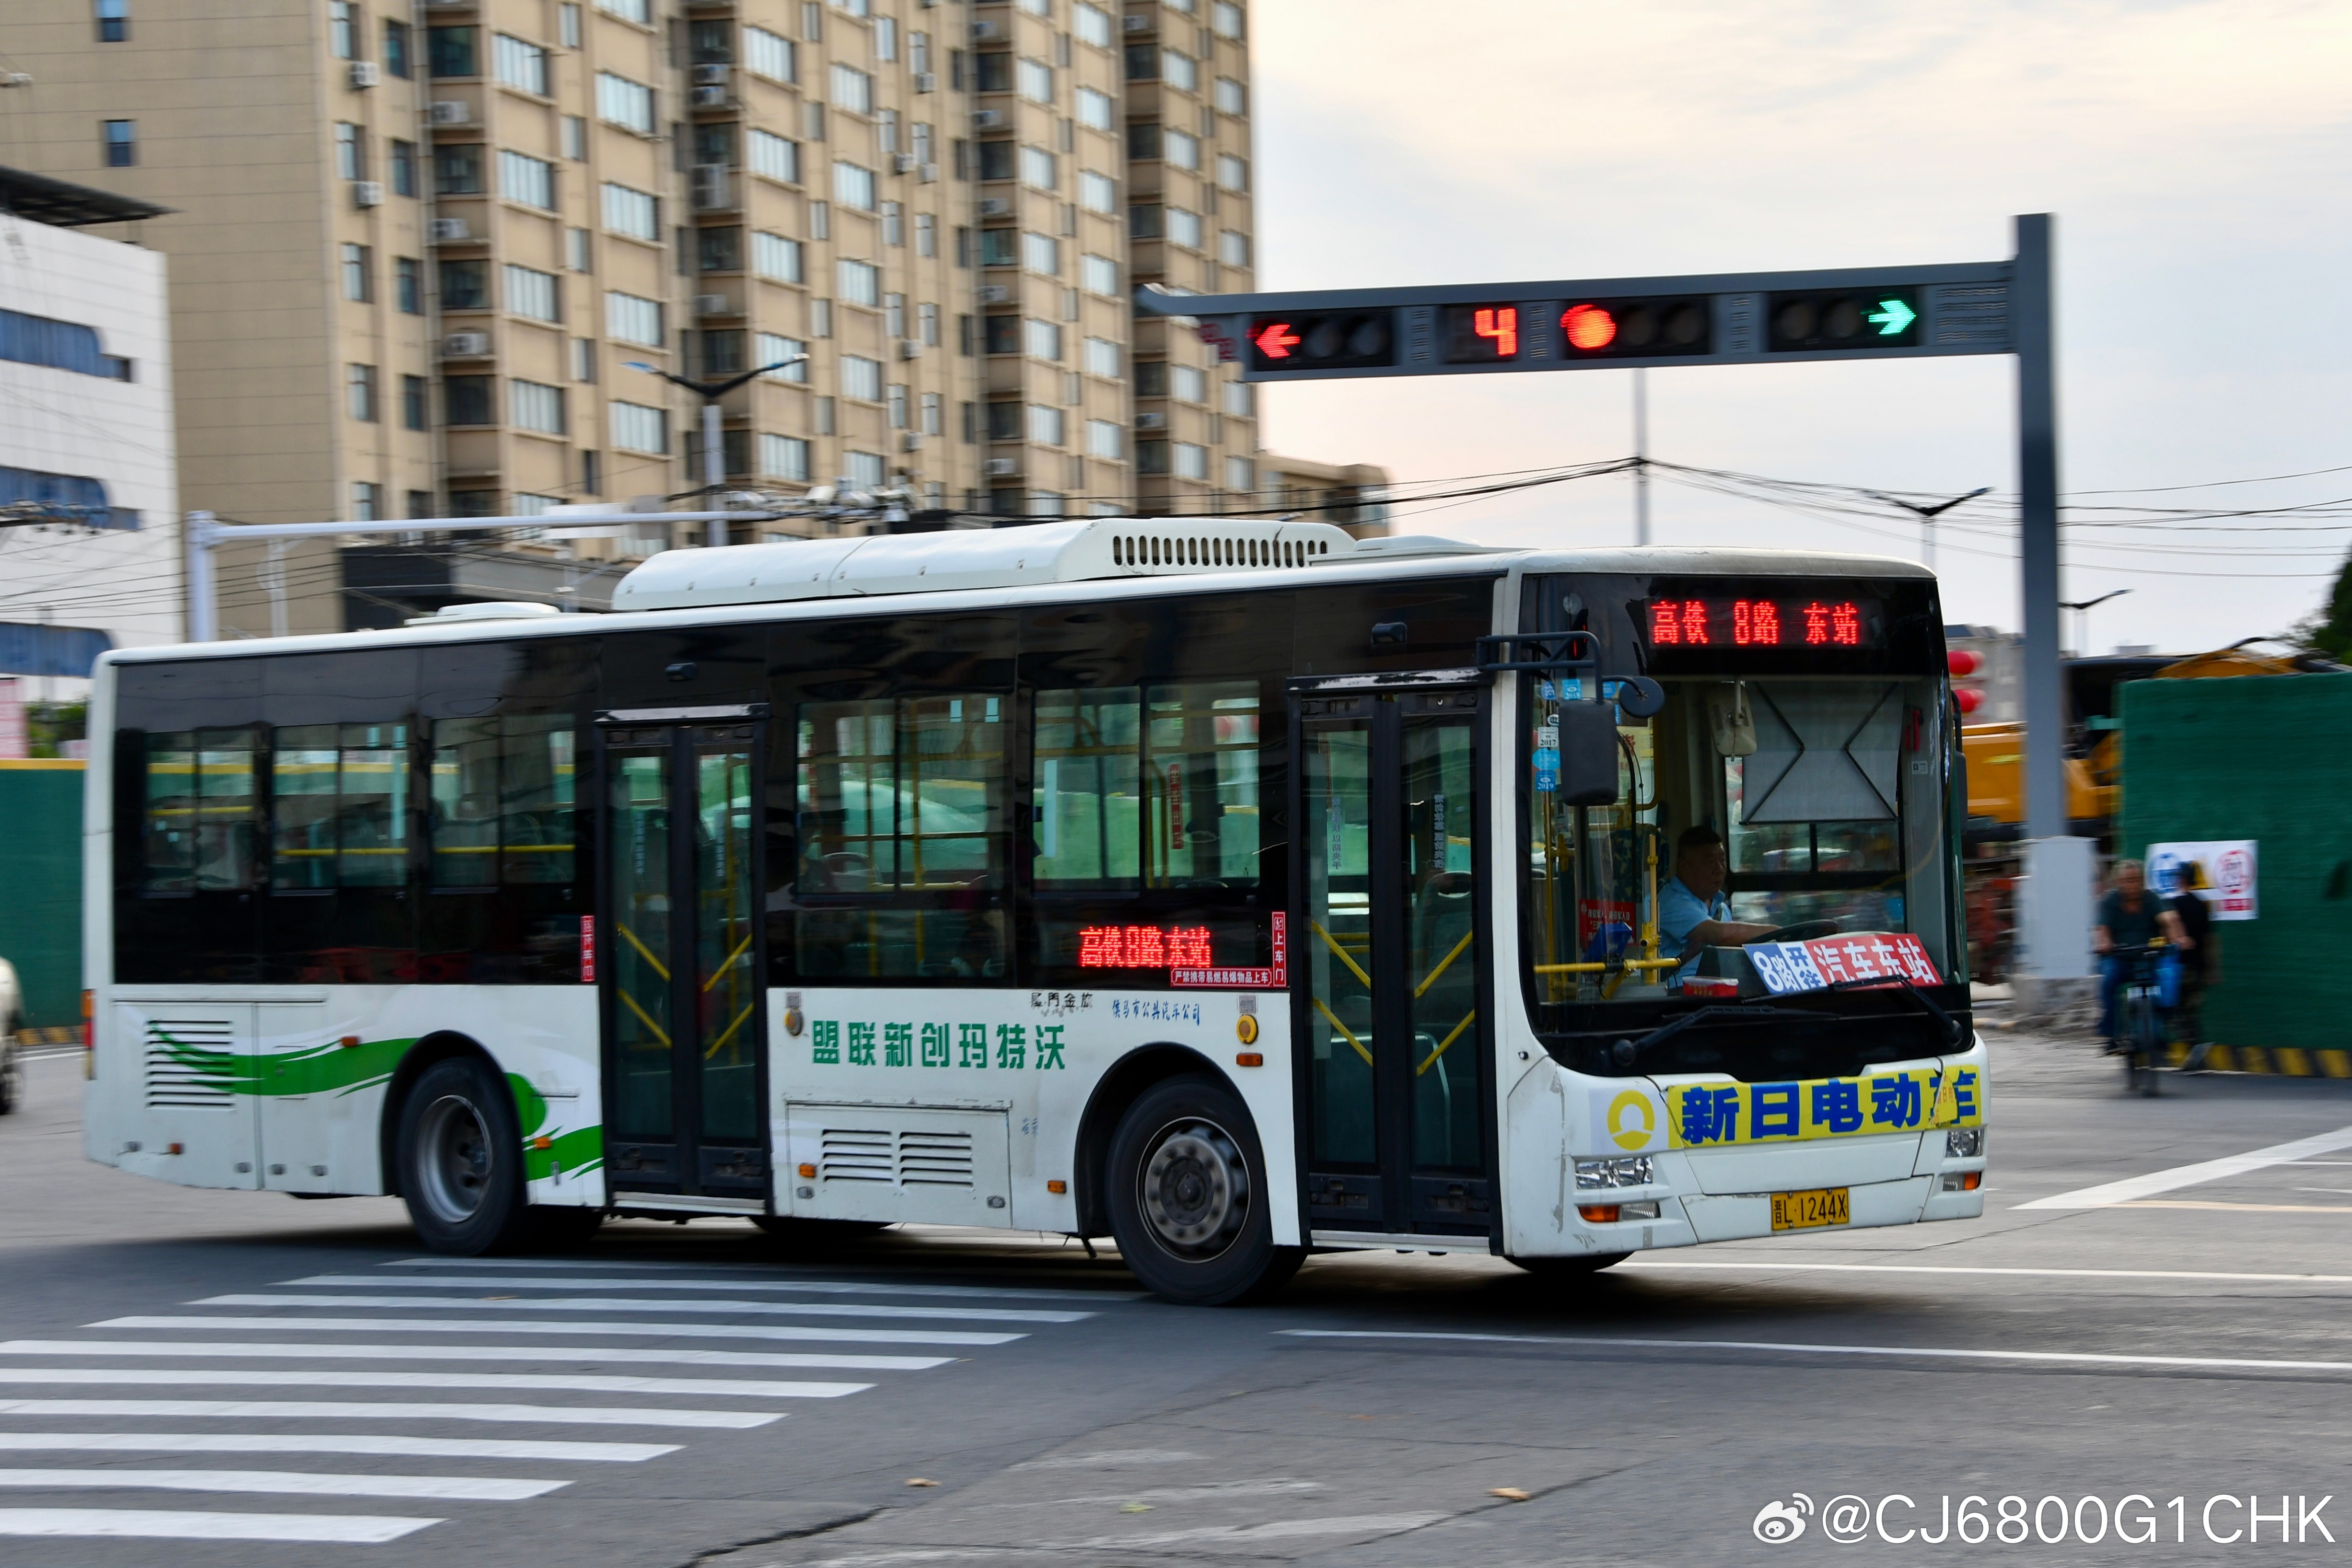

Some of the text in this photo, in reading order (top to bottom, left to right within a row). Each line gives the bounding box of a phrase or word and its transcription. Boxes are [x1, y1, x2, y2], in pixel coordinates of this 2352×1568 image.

[1475, 308, 1517, 356] 4
[1652, 601, 1857, 644] 高铁 8路 东站
[582, 934, 594, 976] 下车门
[1274, 932, 1284, 981] 上车门
[1753, 951, 1799, 992] 8路
[1789, 947, 1821, 987] 开往
[1813, 938, 1936, 983] 汽车东站
[1175, 971, 1269, 984] 严禁携带易燃易爆物品上车
[813, 1021, 1065, 1069] 盟联新创玛特沃
